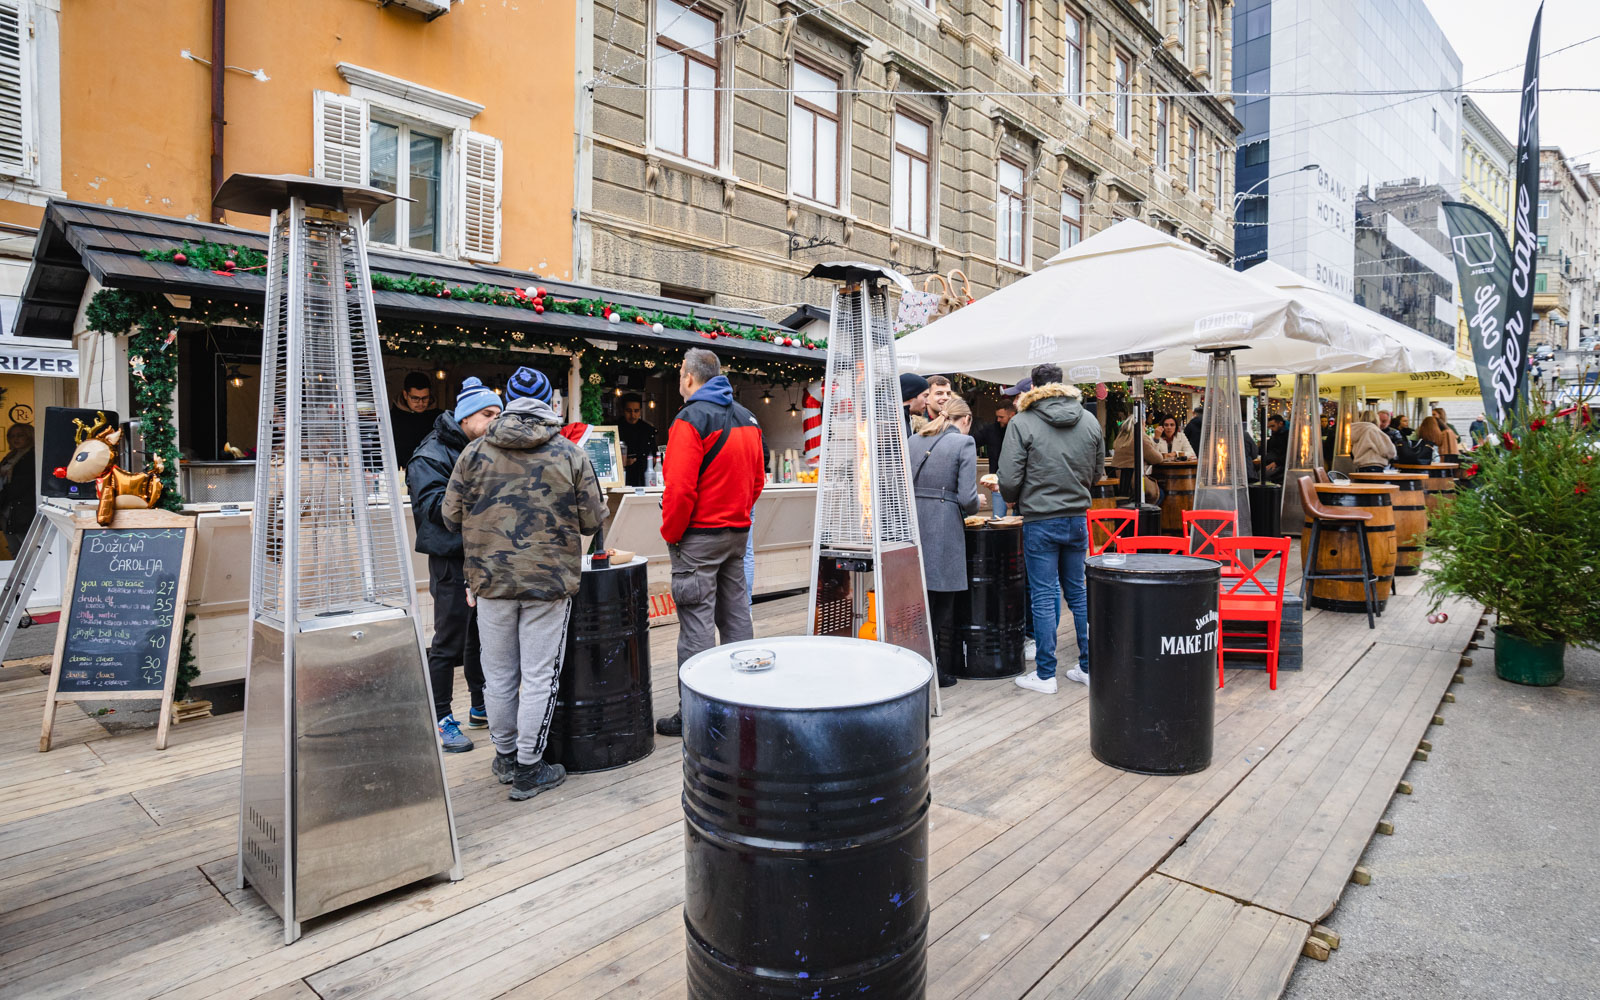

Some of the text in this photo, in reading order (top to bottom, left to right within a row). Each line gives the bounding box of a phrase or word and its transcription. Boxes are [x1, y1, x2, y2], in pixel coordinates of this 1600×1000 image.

[1317, 168, 1347, 202] GRAND
[1317, 200, 1346, 233] HOTEL
[1316, 263, 1354, 295] BONAVIA
[109, 554, 163, 577] ČAROLIJA
[80, 580, 97, 593] you
[156, 581, 175, 596] 27
[77, 594, 103, 604] drunk
[153, 598, 174, 612] 35
[157, 614, 174, 628] 35
[72, 627, 96, 640] jingle
[98, 629, 113, 638] bell
[149, 634, 166, 649] 40
[1160, 634, 1202, 655] MAKE
[1204, 631, 1214, 652] IT
[140, 655, 161, 670] 30
[143, 670, 163, 685] 45
